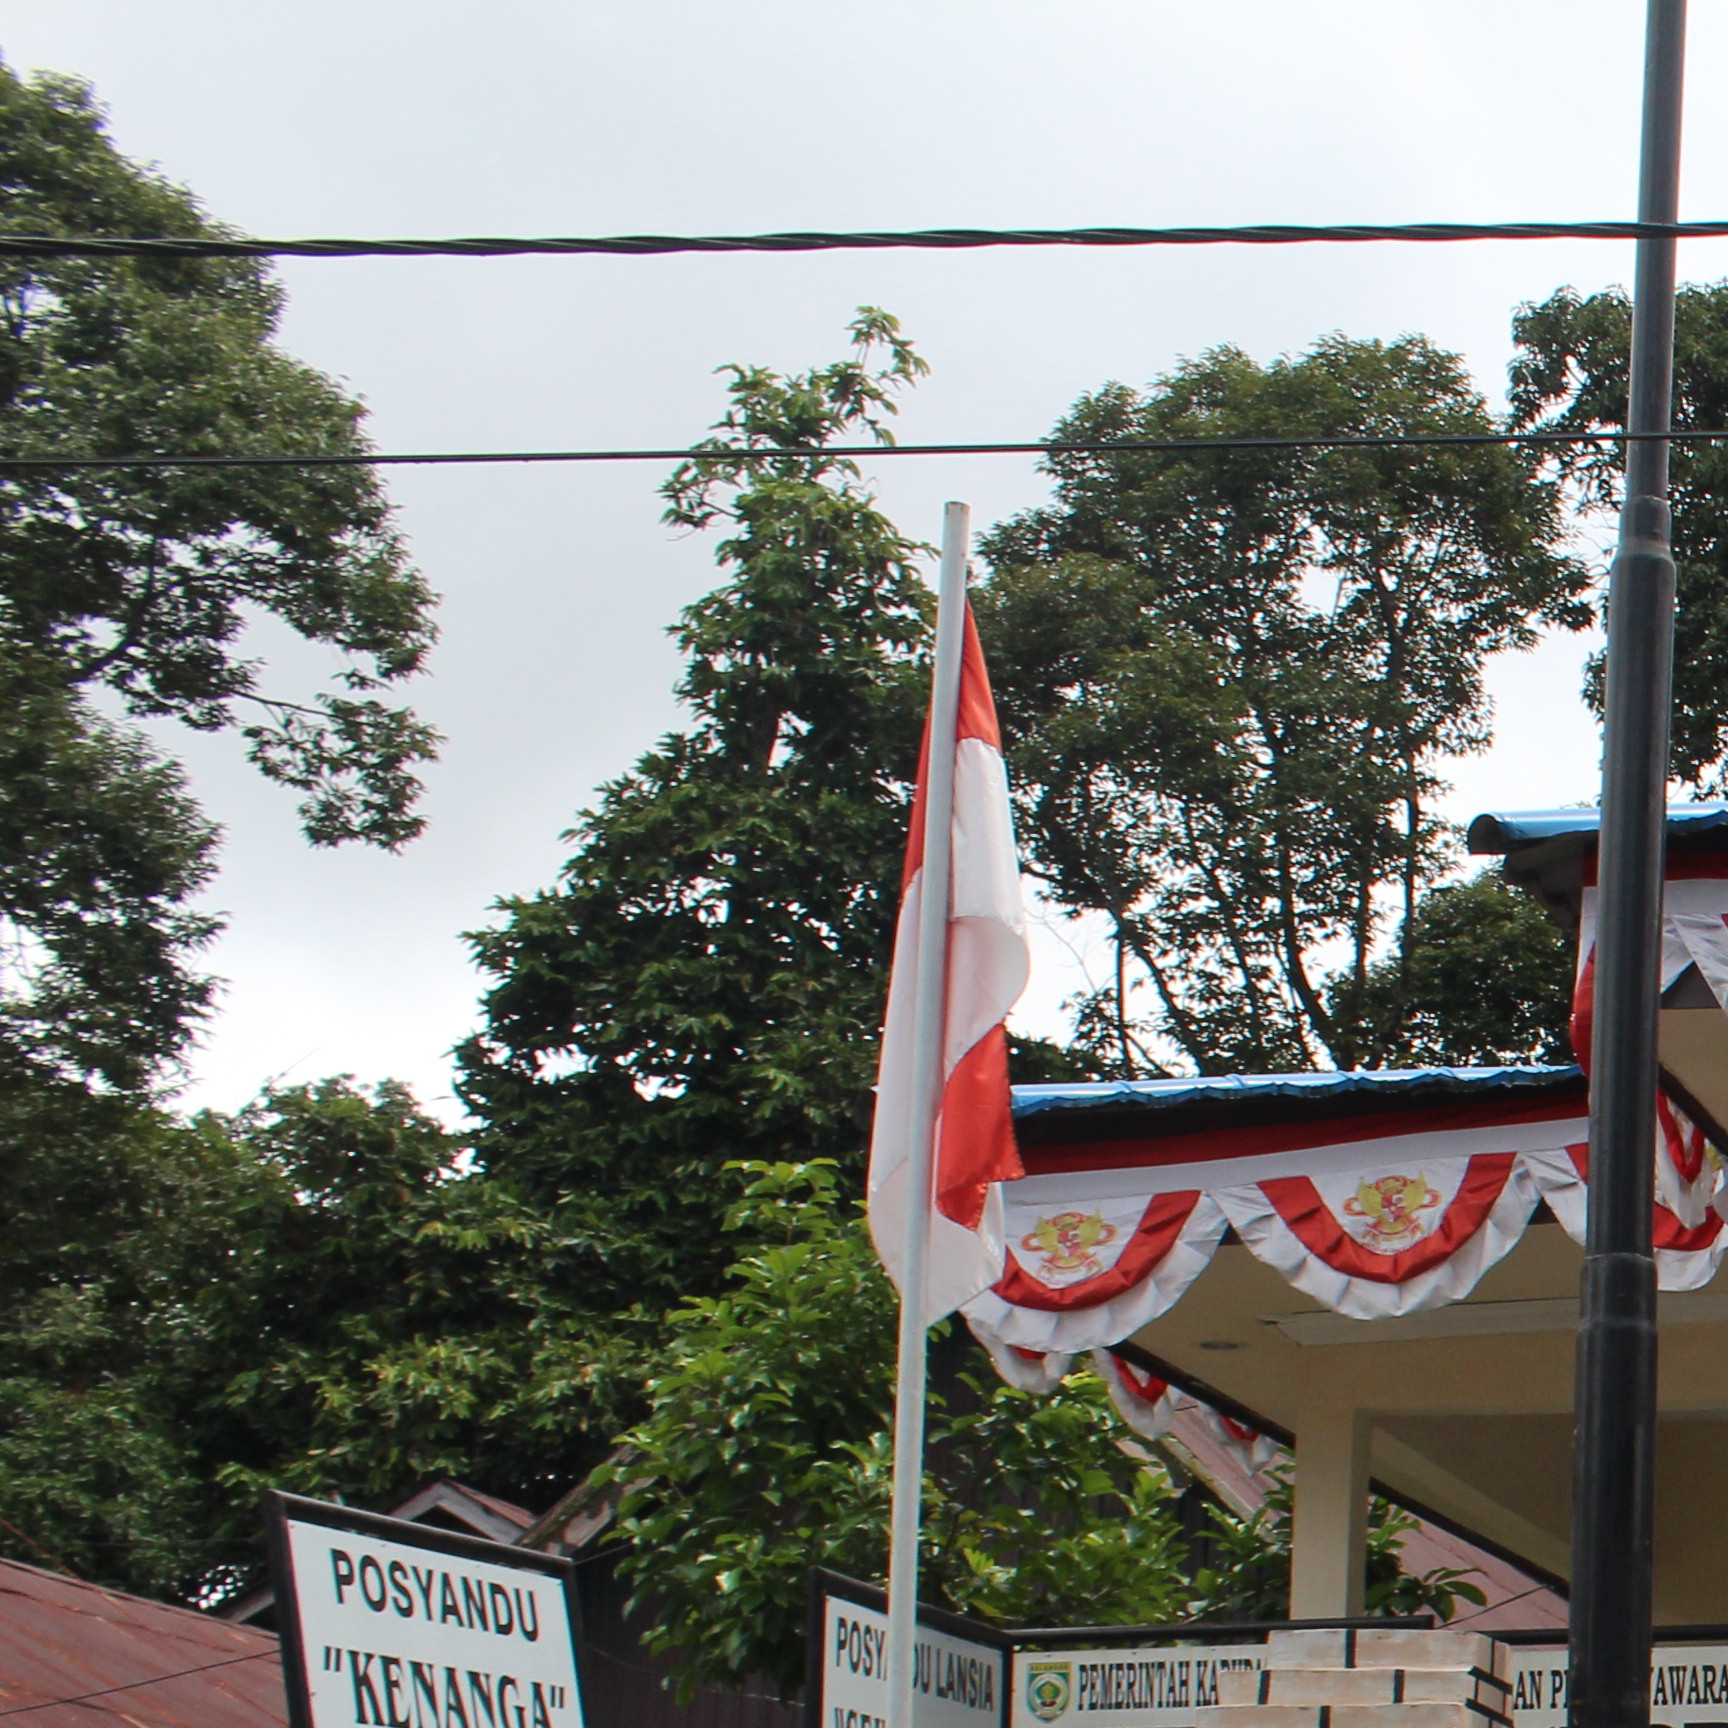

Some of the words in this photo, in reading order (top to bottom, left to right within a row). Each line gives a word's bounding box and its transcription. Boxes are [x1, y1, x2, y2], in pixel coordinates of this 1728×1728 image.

[330, 1548, 539, 1642] POSYANDU
[936, 1647, 993, 1712] LANSIA
[1077, 1661, 1189, 1711] PEMERINTAH
